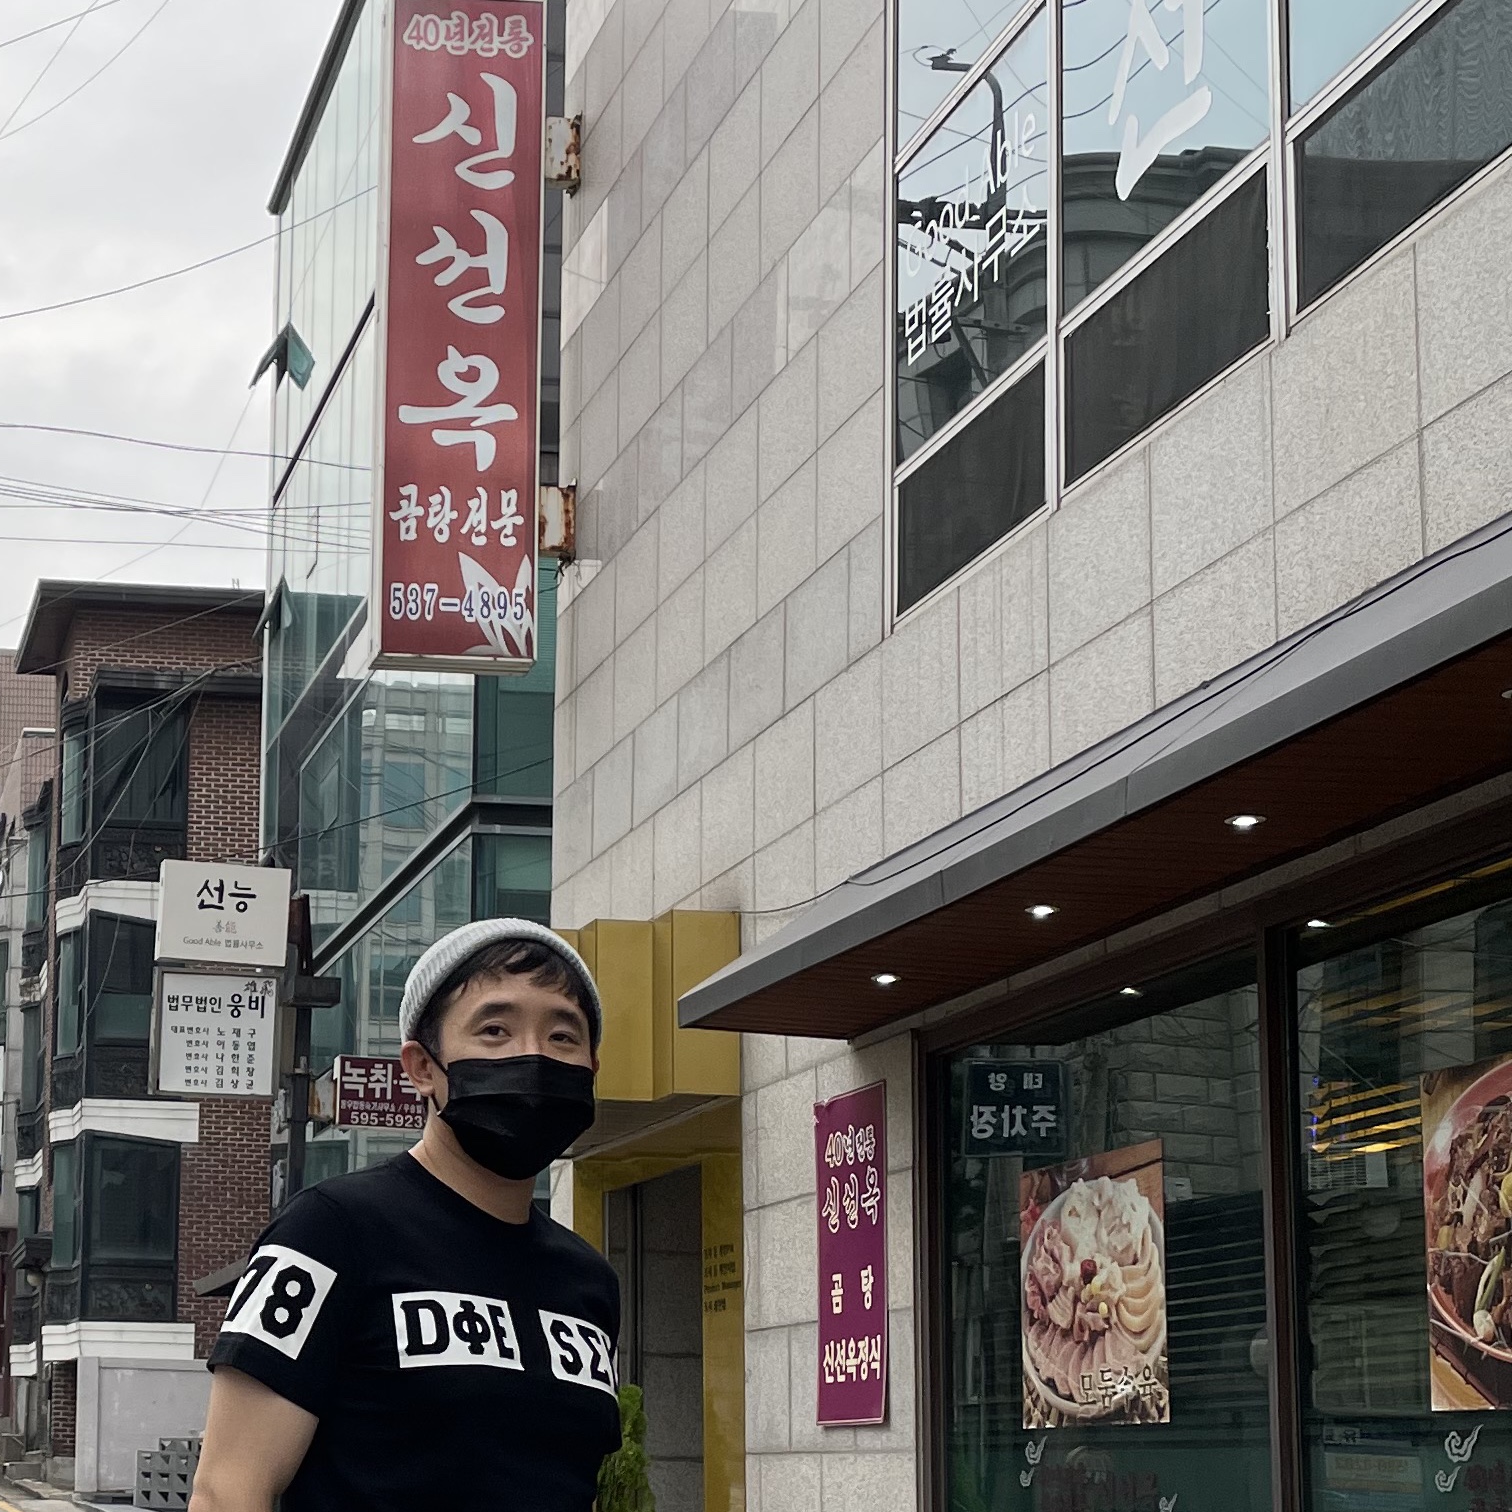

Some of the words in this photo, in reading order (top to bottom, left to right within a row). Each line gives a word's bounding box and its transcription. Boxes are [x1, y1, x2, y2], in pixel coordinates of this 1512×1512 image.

[403, 10, 534, 58] 40년전통
[904, 185, 1039, 366] 법률사무소
[391, 583, 525, 621] 537-4895
[197, 879, 257, 913] 선능
[183, 936, 203, 945] Good
[205, 938, 221, 946] Able
[168, 995, 222, 1013] 법무법인
[227, 994, 265, 1019] 웅비
[171, 1026, 209, 1035] 대표변호사
[186, 1040, 209, 1048] 변호사
[186, 1053, 208, 1061] 변호사
[185, 1065, 208, 1074] 변호사
[185, 1079, 207, 1087] 변호사
[350, 1111, 423, 1128] 595-5923
[822, 1334, 881, 1383] 신선옥정식
